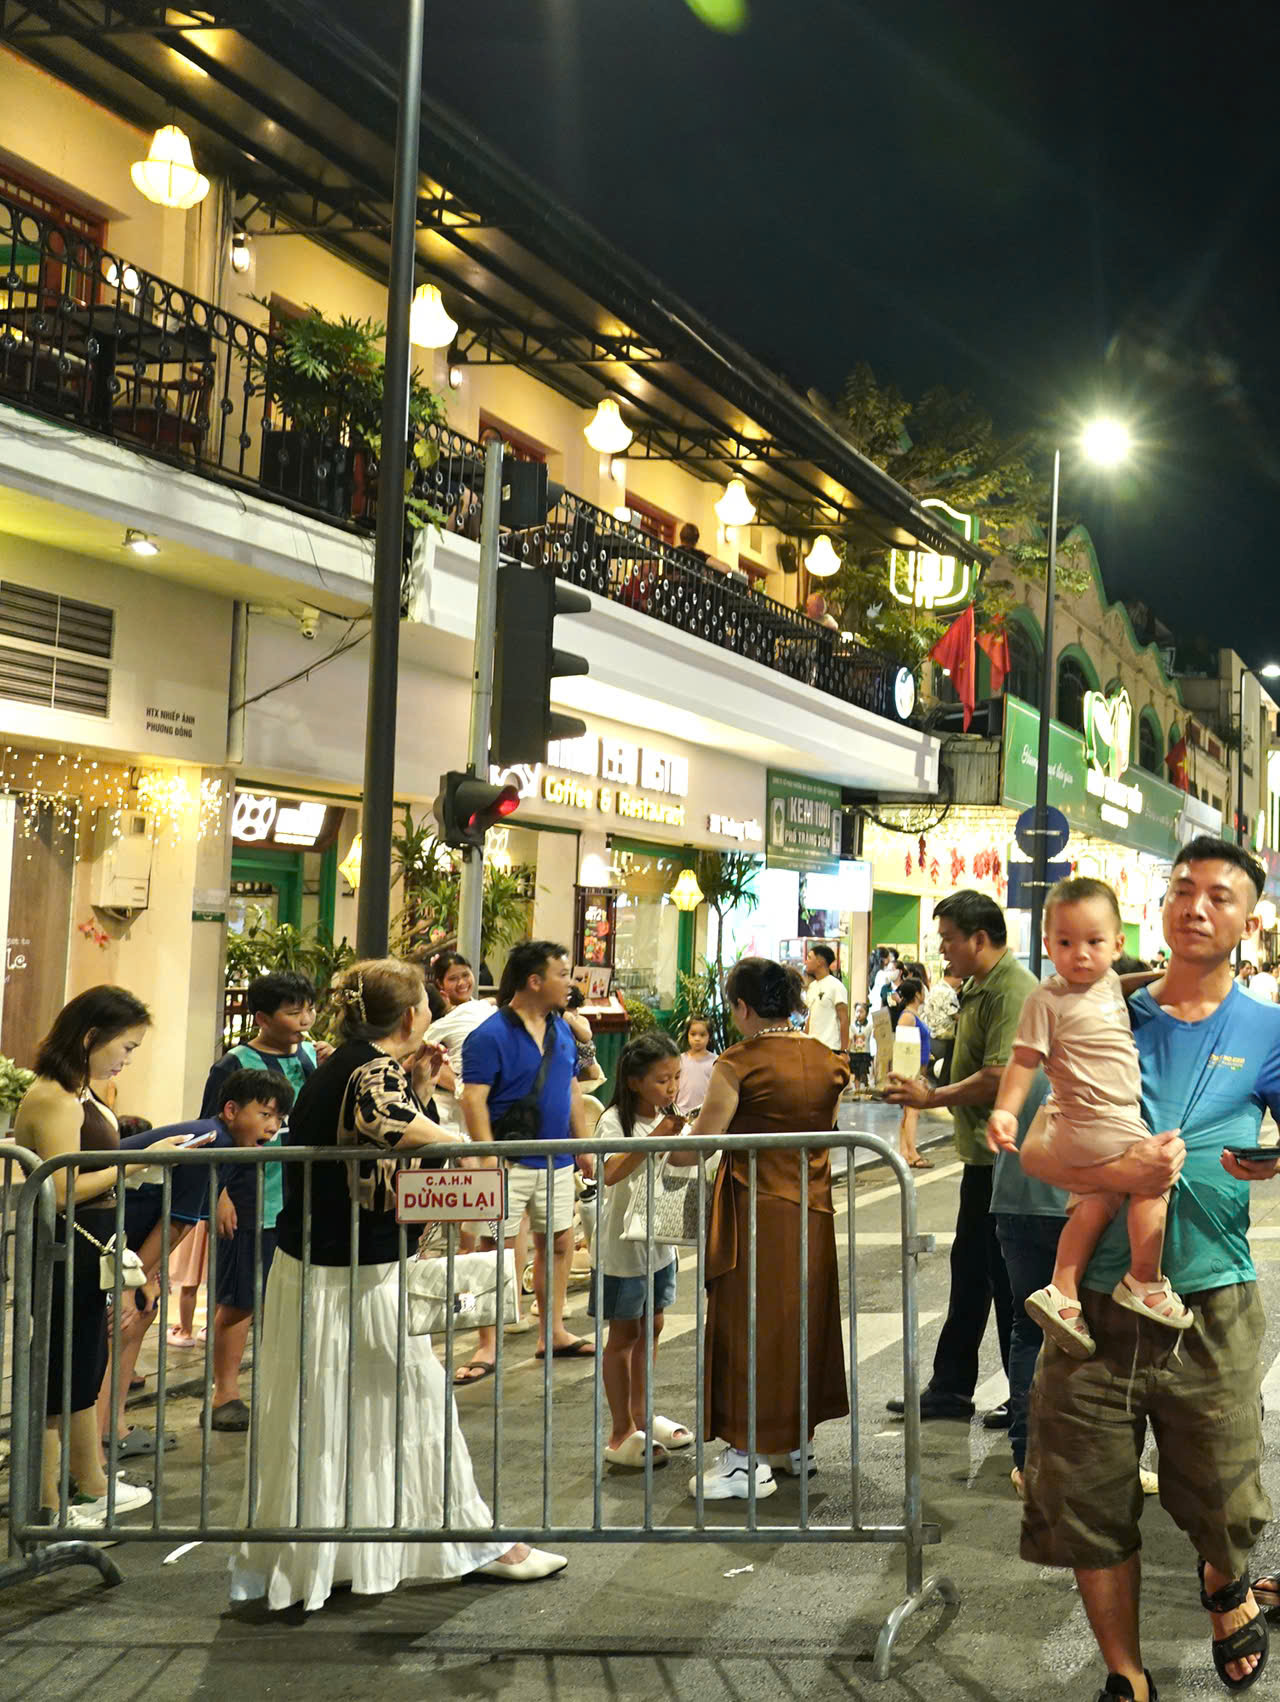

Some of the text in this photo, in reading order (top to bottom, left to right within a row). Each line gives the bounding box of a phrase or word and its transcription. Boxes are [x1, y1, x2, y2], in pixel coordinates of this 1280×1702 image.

[146, 707, 159, 719] HTX
[545, 775, 593, 809] Coffee
[600, 786, 612, 814] &
[618, 791, 686, 827] Restaurant
[789, 796, 814, 825] KEM
[426, 1176, 472, 1186] C.A.H.N
[404, 1187, 495, 1211] DỪNG LẠI
